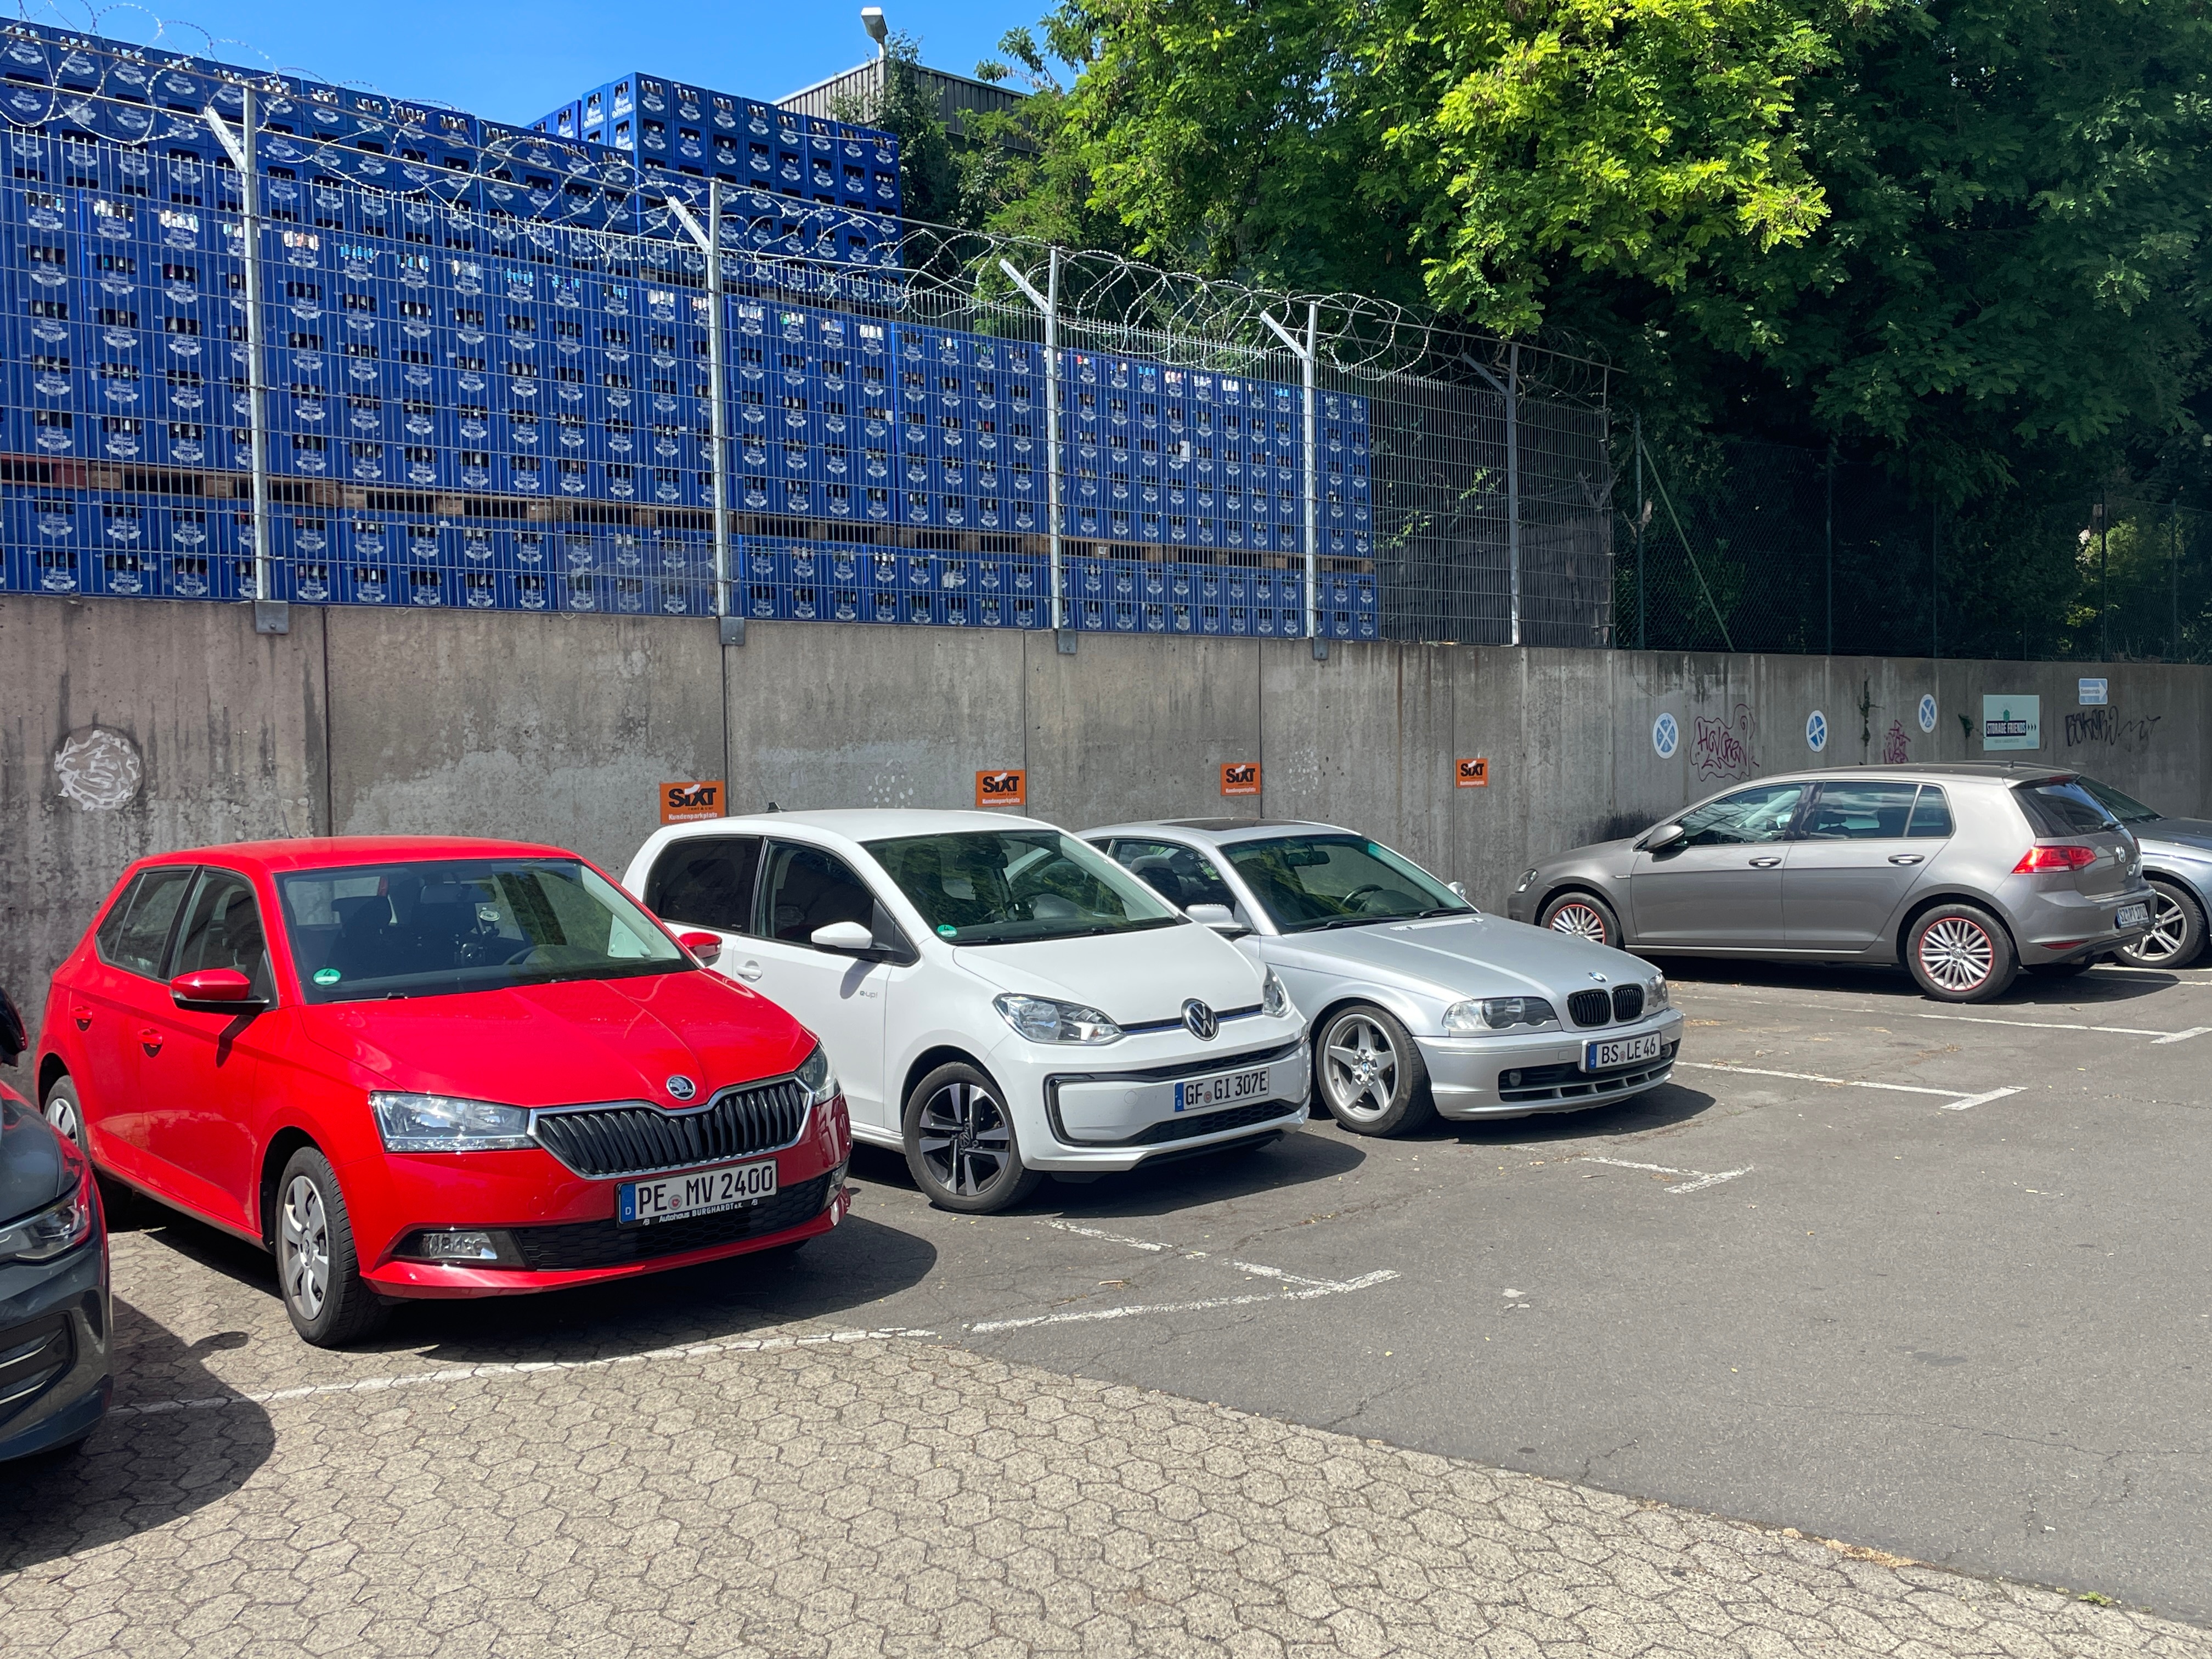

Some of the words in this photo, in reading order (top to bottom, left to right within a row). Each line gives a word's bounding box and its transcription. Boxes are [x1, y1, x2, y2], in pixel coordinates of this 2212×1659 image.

[1601, 1044, 1618, 1064] BS
[1627, 1040, 1641, 1060] LE
[1643, 1037, 1656, 1057] 46
[1186, 1082, 1204, 1105] GF
[1214, 1078, 1231, 1100] GI
[1235, 1070, 1267, 1096] 307E
[638, 1184, 668, 1214] PE
[686, 1175, 714, 1206] MV
[721, 1165, 773, 1200] 2400
[659, 1211, 690, 1223] Autohaus
[692, 1203, 734, 1217] BURGHARDT
